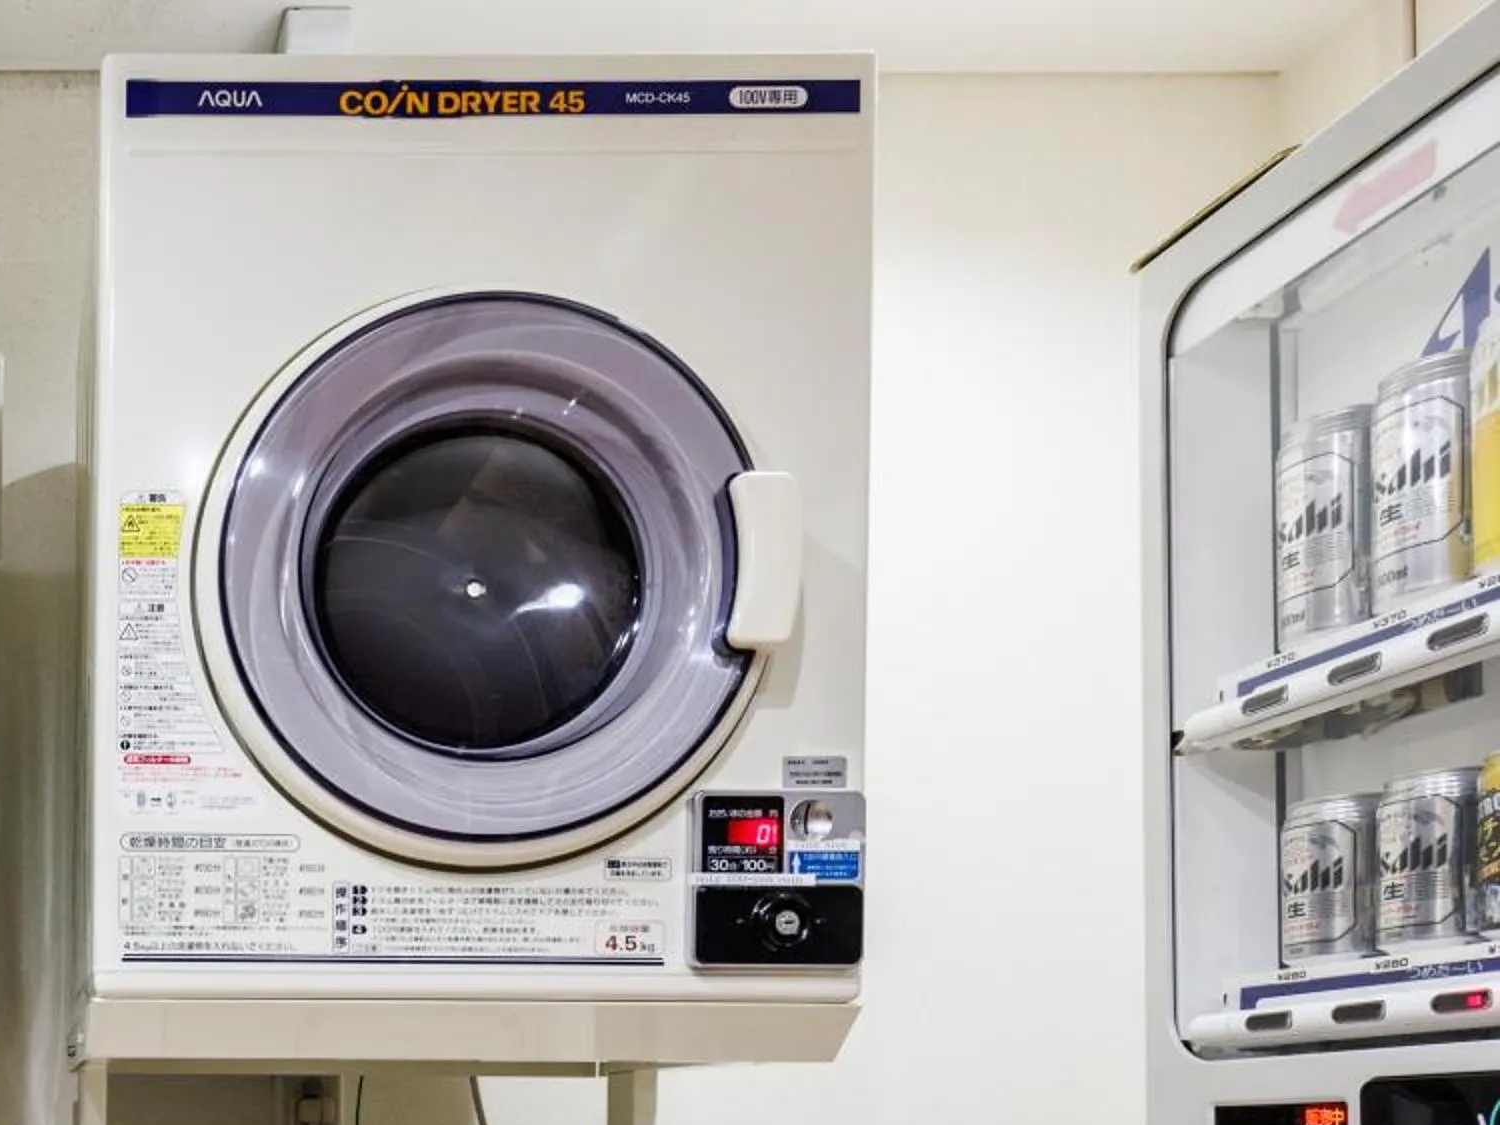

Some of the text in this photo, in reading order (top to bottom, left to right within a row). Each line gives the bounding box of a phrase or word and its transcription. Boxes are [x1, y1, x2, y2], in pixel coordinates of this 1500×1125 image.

[199, 84, 691, 115] AQUA COIN DRYER 45 MCD-CK45
[129, 837, 227, 849] 乾燥時間の目安
[1382, 881, 1405, 901] 生
